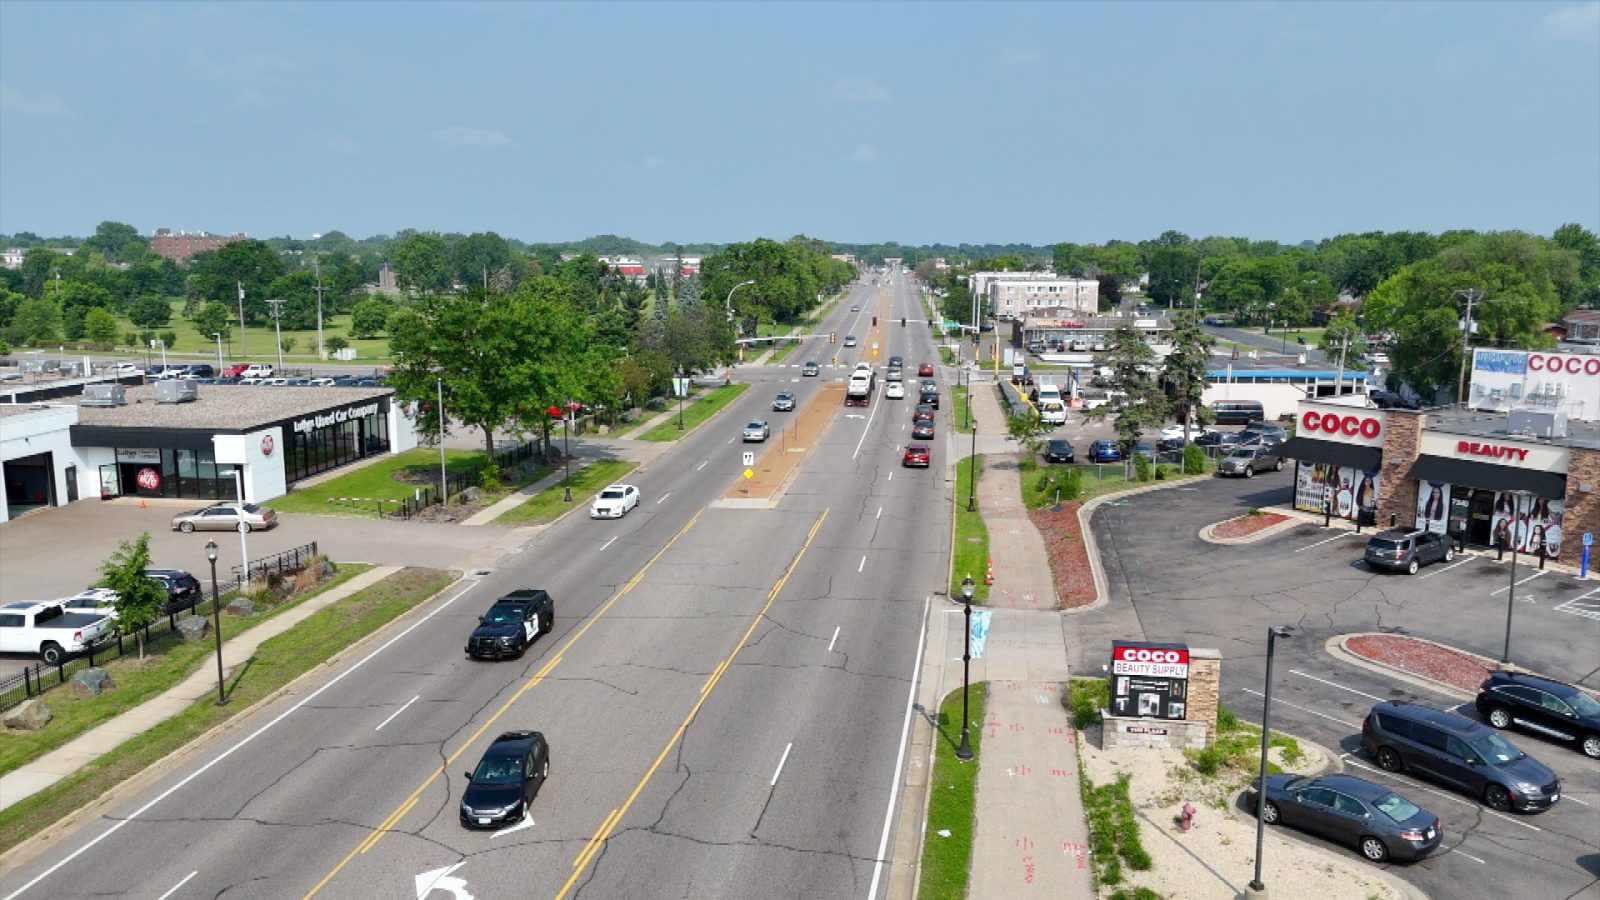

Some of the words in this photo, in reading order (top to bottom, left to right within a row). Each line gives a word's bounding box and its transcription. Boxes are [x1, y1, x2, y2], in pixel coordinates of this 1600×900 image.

[1528, 354, 1600, 376] COCO
[315, 411, 335, 429] Used
[335, 409, 347, 423] Car
[348, 403, 378, 419] Company
[1302, 411, 1381, 439] COCO
[1457, 441, 1530, 461] BEAUTY
[1123, 649, 1180, 663] COCO
[1116, 663, 1150, 673] BEAUTY
[1152, 664, 1186, 676] SUPPLY
